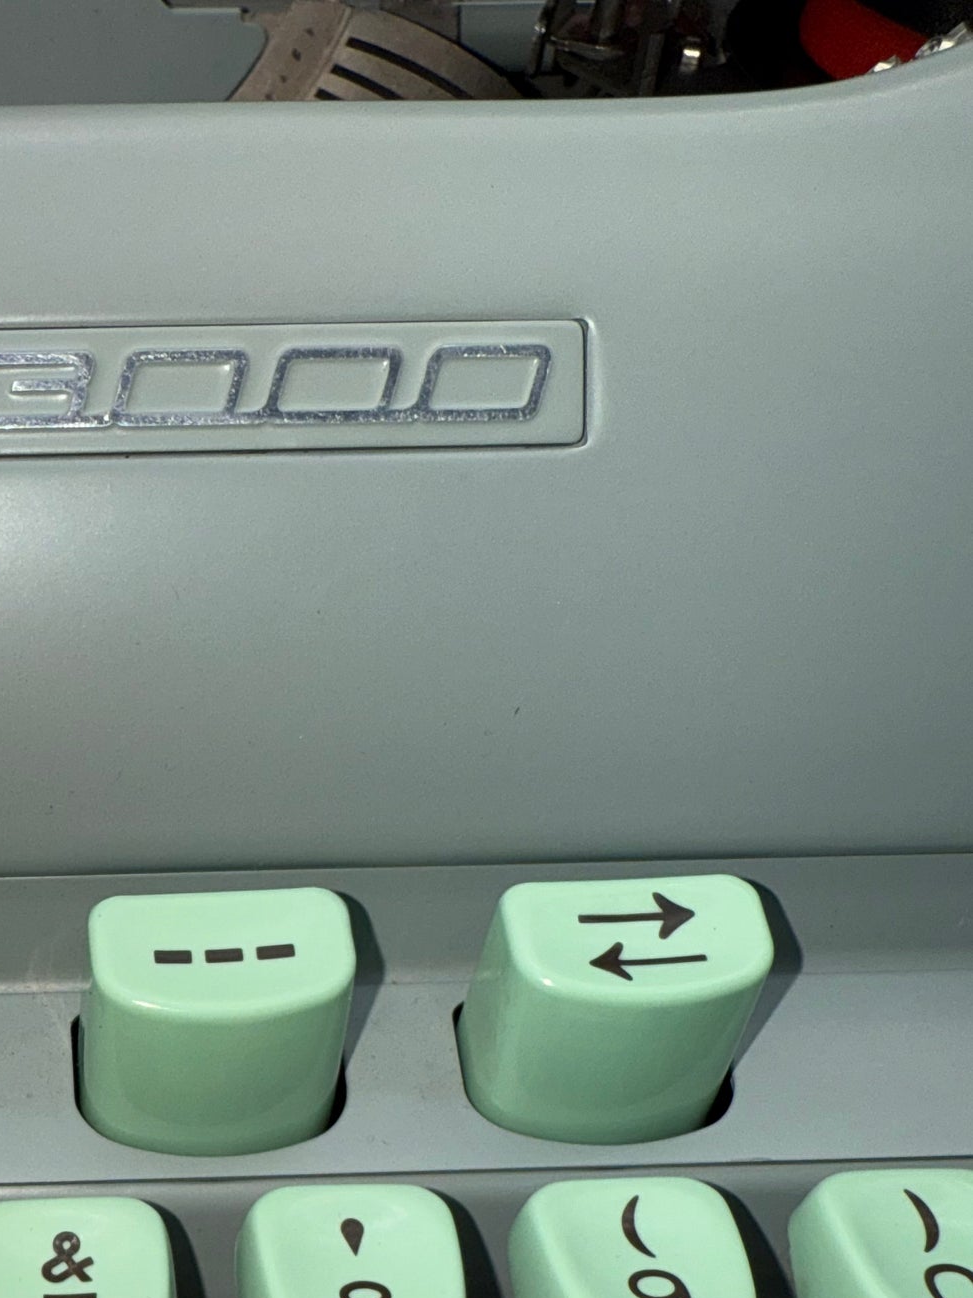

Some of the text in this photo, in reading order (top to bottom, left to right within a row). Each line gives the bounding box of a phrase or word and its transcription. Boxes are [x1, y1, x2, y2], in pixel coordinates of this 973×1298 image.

[621, 1195, 656, 1259] (
[903, 1188, 940, 1253] )
[41, 1231, 94, 1284] &
